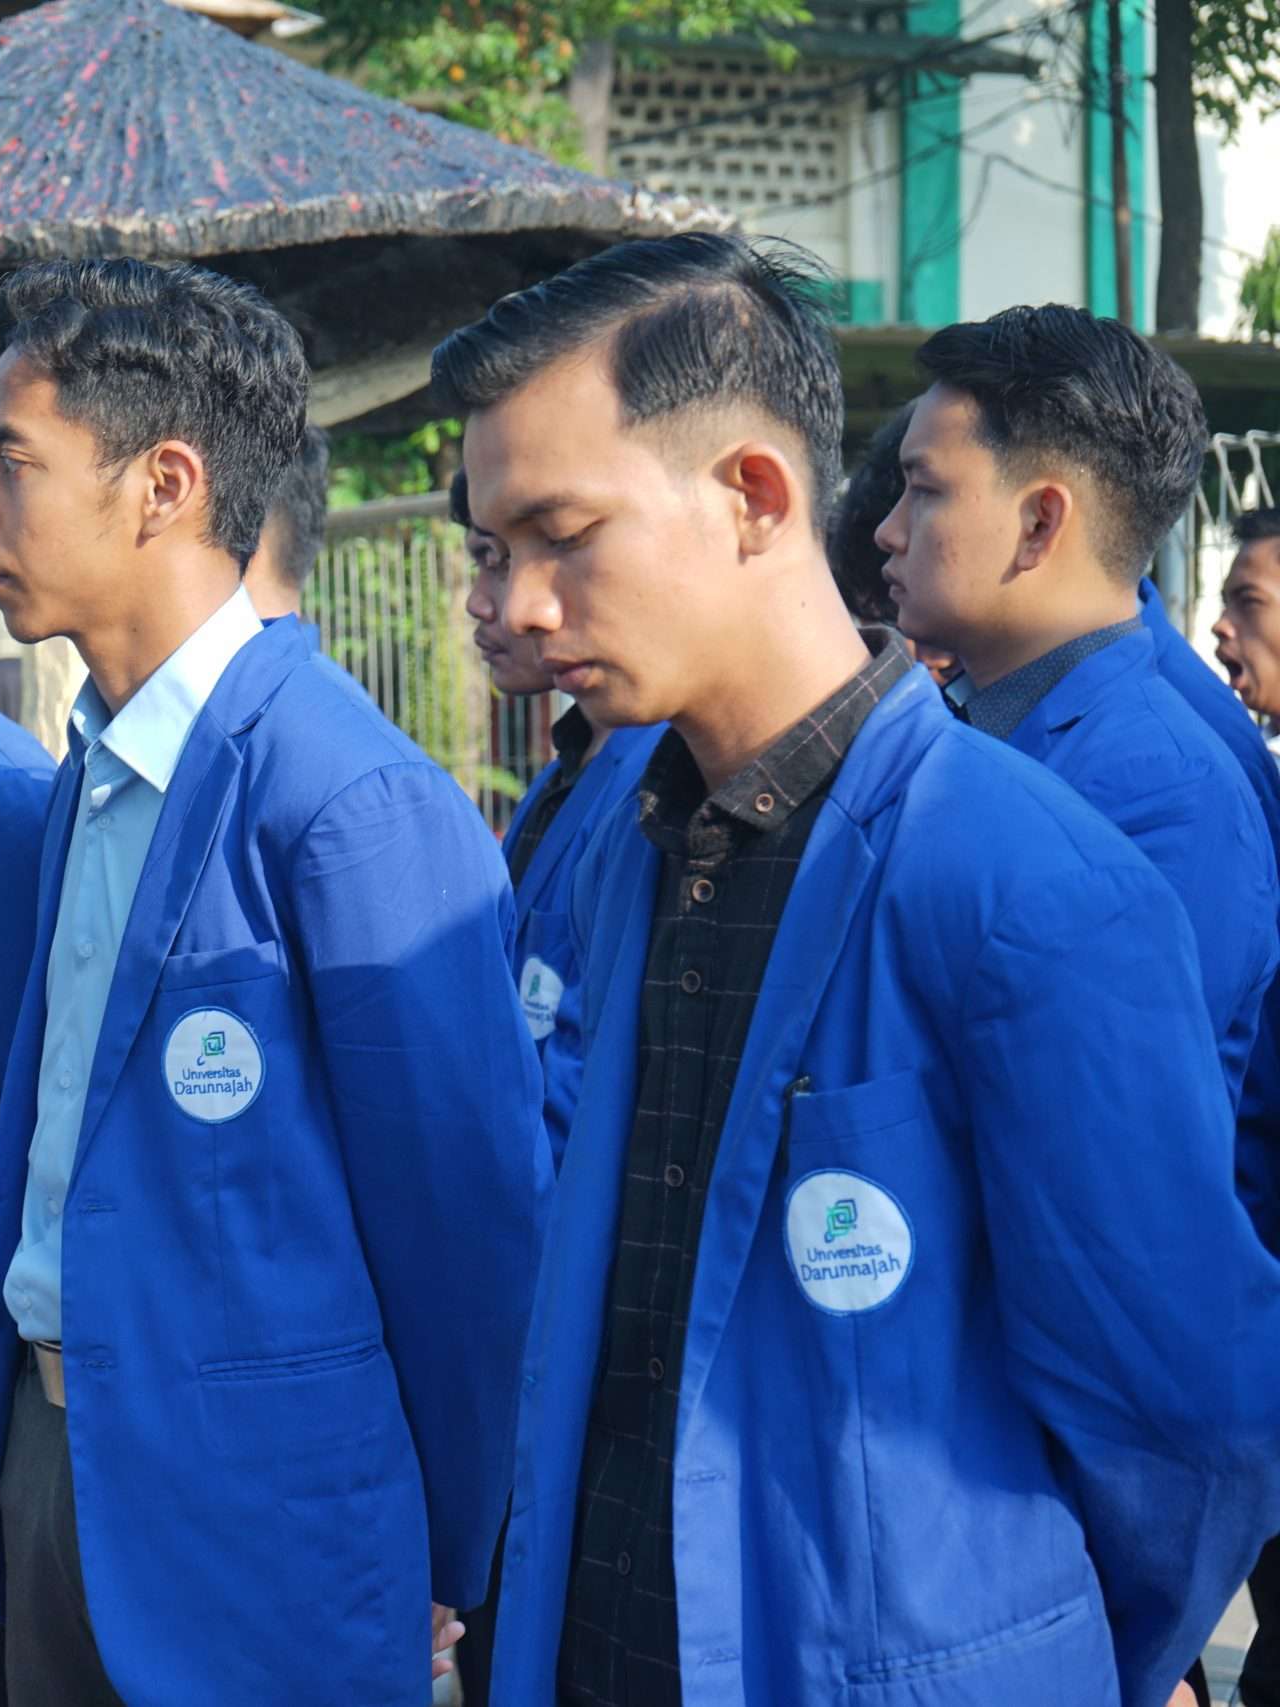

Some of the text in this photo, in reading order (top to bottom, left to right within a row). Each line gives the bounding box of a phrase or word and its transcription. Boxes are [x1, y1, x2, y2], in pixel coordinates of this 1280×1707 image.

[182, 1066, 242, 1080] Universitas
[174, 1076, 253, 1097] Darunnajah
[806, 1244, 883, 1263] Universitas
[800, 1252, 901, 1282] Darunnajah
